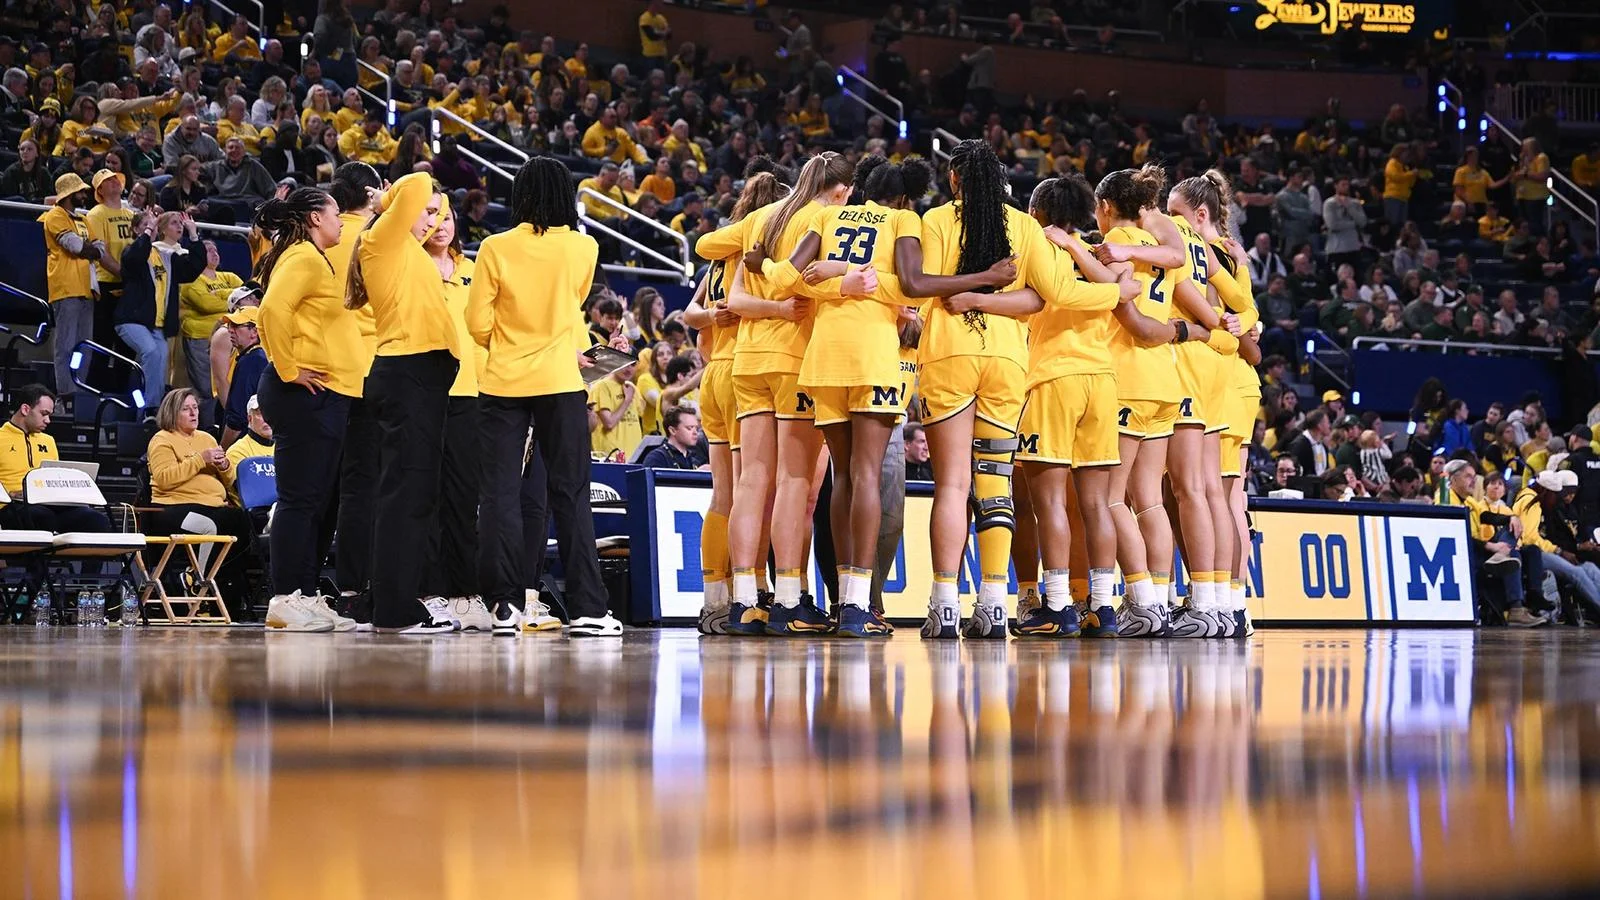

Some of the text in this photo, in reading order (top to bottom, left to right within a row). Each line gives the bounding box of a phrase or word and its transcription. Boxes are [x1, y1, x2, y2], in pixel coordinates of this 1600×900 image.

[827, 226, 878, 265] 33
[1188, 242, 1208, 285] 15
[1149, 265, 1165, 303] 2
[872, 385, 899, 406] M
[37, 444, 49, 453] M
[1017, 433, 1039, 454] M
[590, 488, 617, 501] HIGAN
[1300, 533, 1350, 599] 00
[1403, 535, 1461, 601] M
